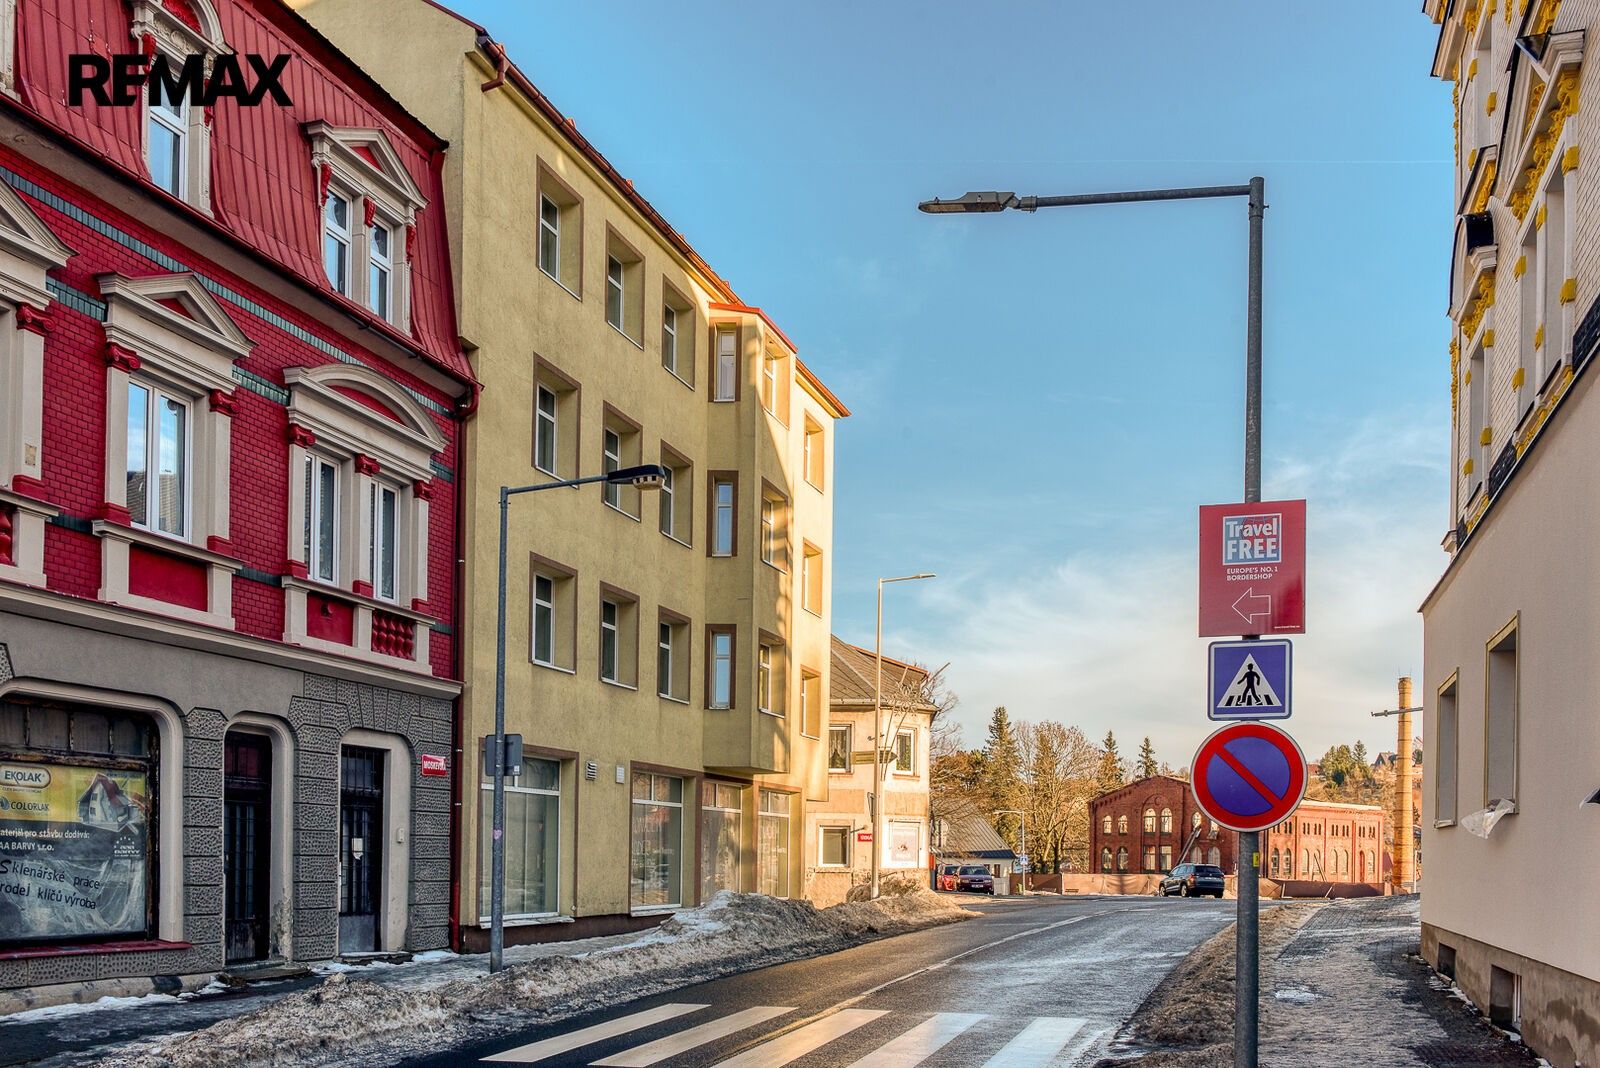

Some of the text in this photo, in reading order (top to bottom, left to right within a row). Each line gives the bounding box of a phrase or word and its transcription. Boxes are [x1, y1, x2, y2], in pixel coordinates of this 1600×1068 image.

[1225, 517, 1278, 538] Travel
[1226, 538, 1278, 560] FREE
[1226, 567, 1259, 575] EUROPE'S
[1226, 573, 1273, 581] BORDERSHOP
[4, 770, 42, 784] EKOLAK
[10, 801, 49, 812] COLORLAK
[11, 841, 36, 850] BARVY
[73, 875, 101, 890] práce
[64, 892, 96, 909] výroba
